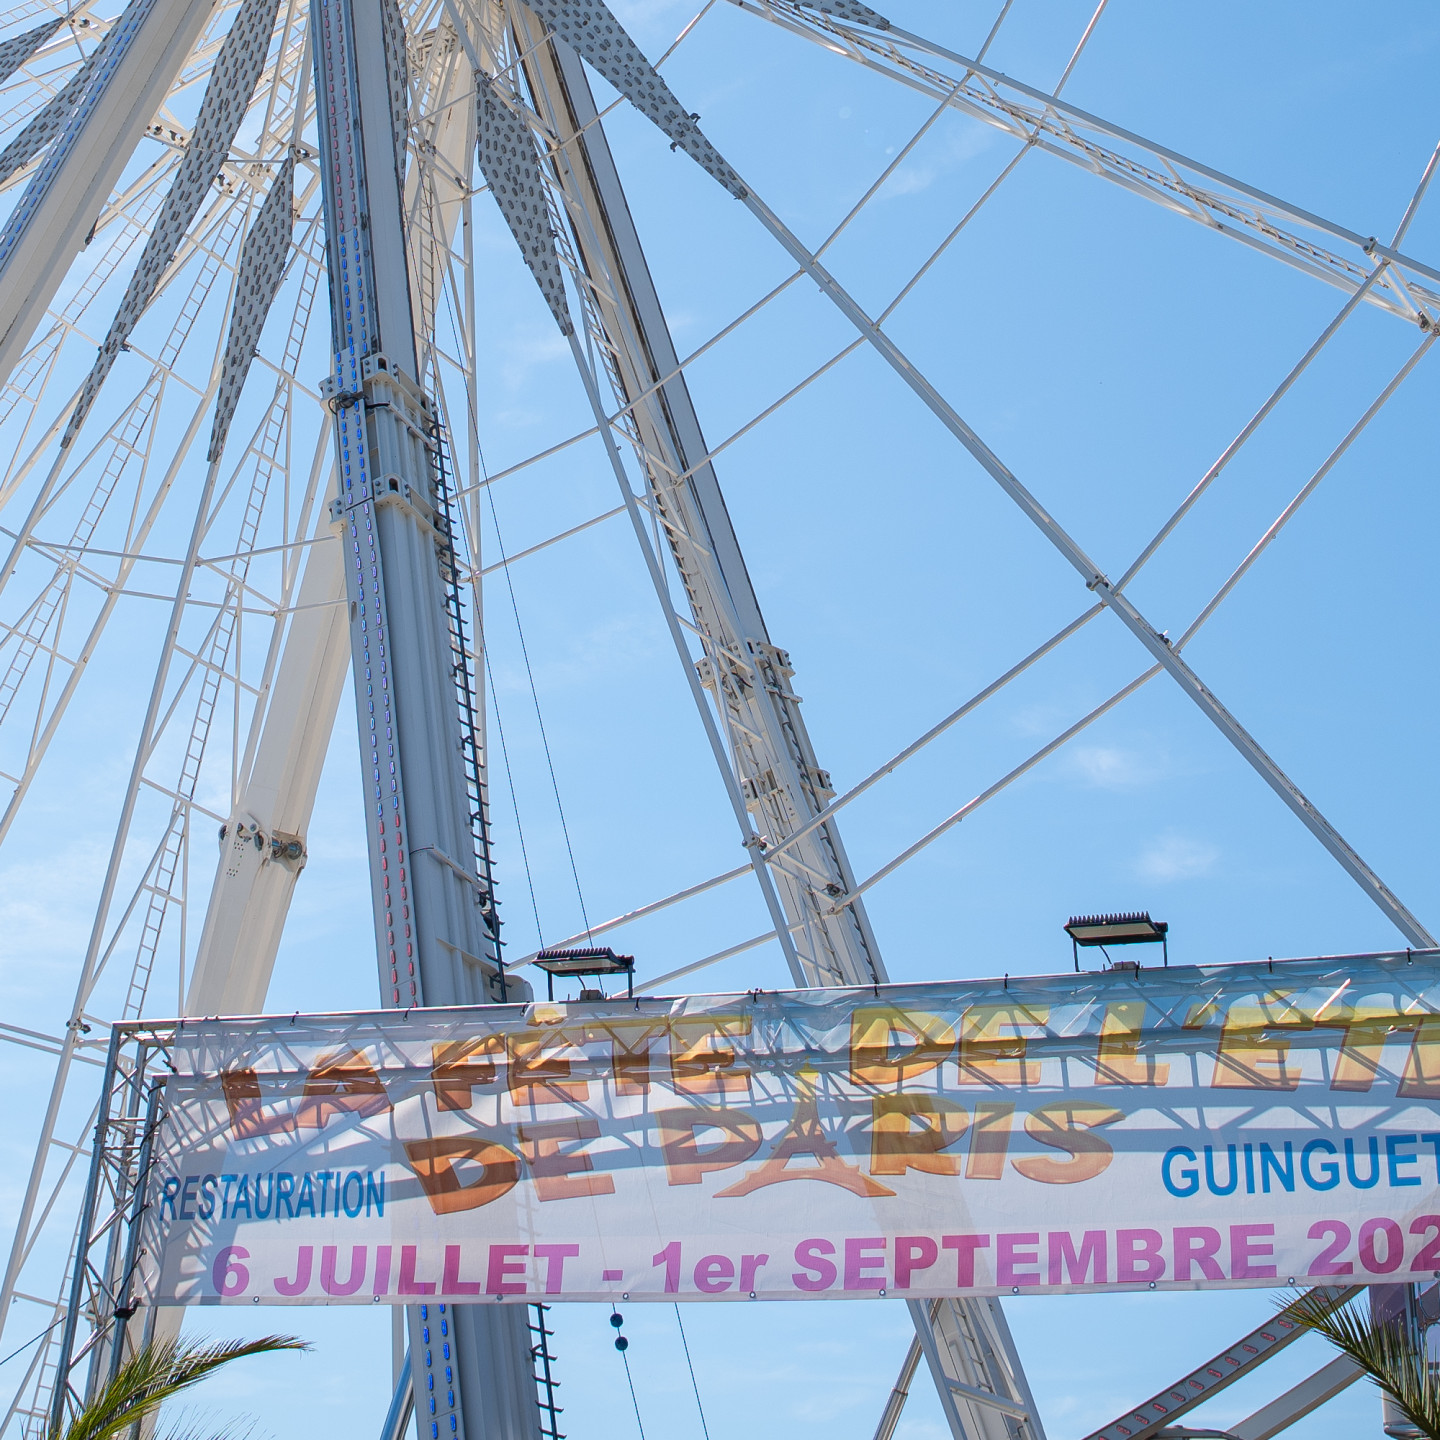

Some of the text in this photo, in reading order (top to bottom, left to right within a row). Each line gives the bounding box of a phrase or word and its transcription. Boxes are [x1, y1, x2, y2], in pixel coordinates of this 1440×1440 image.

[221, 1047, 395, 1141] LA
[432, 1007, 753, 1113] FÊTE
[849, 1004, 1051, 1086] DE
[402, 1056, 1127, 1216] DE PARIS
[159, 1170, 386, 1222] RESTAURATION
[212, 1245, 251, 1297] 6
[273, 1243, 580, 1297] JUILLET
[602, 1269, 623, 1281] -
[651, 1240, 769, 1294] 1er
[791, 1222, 1278, 1293] SEPTEMBRE
